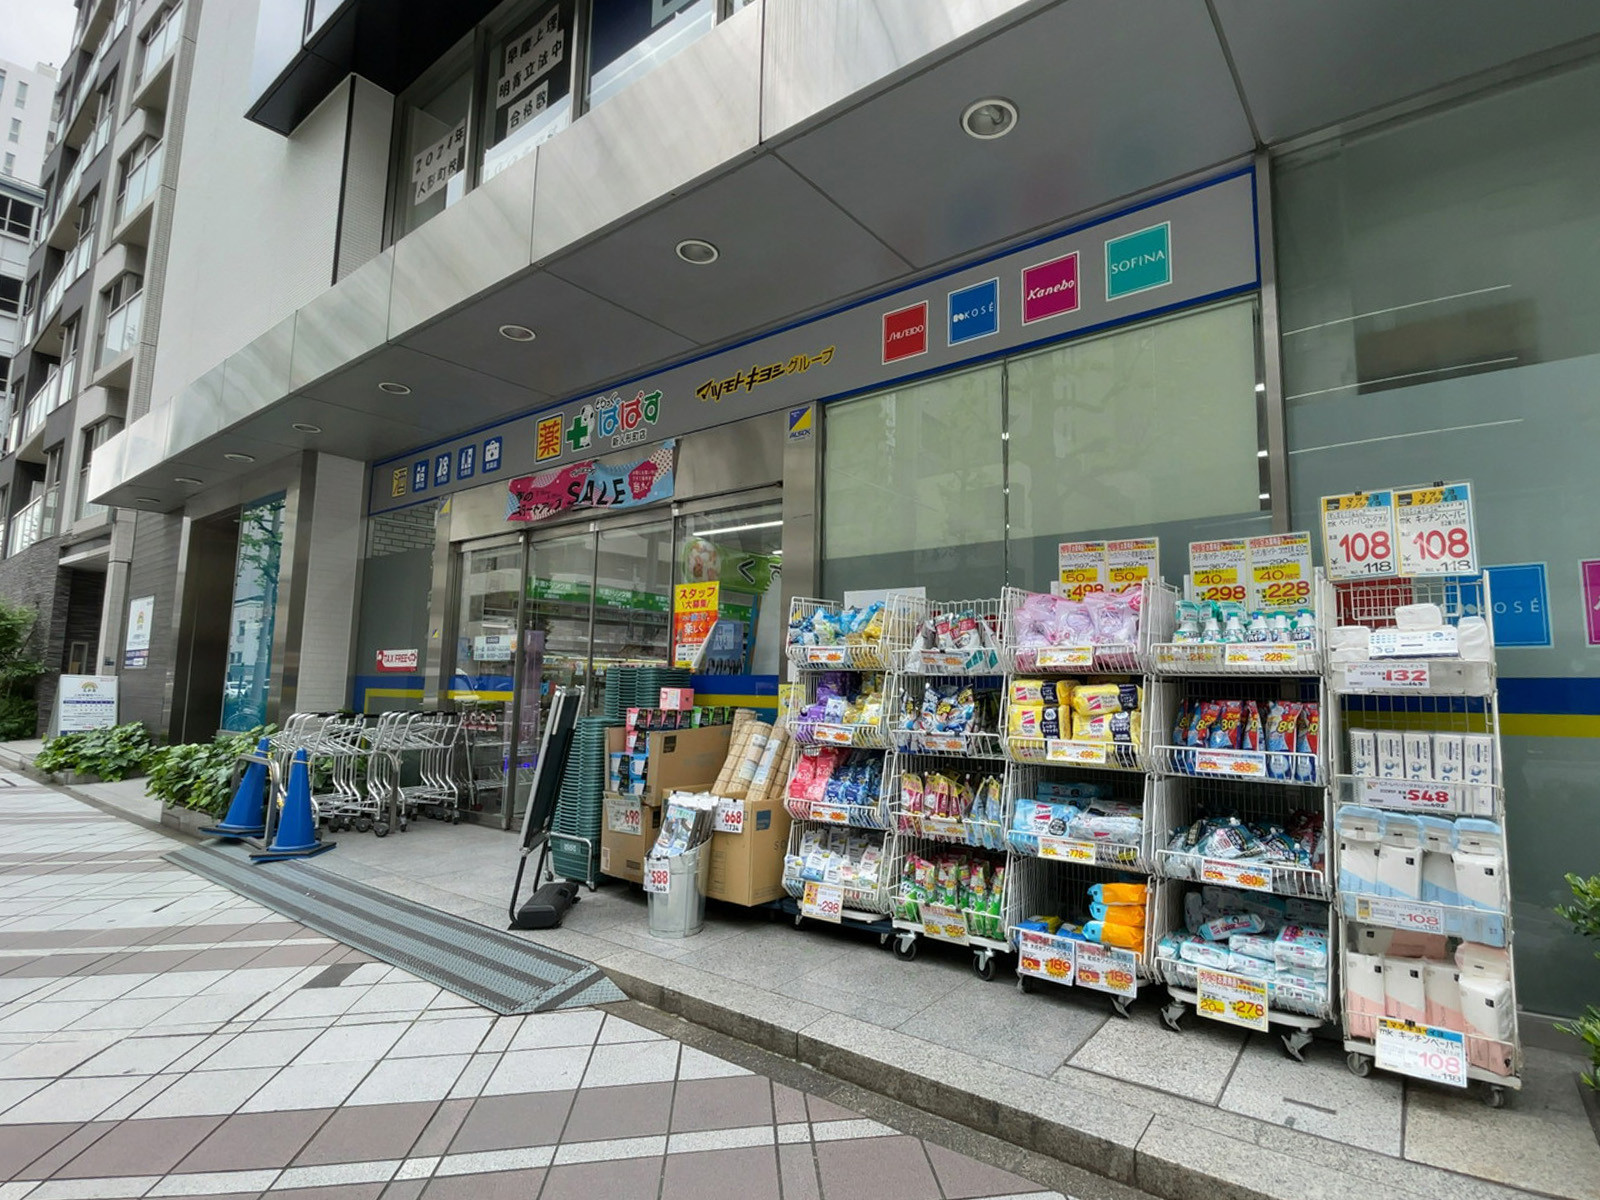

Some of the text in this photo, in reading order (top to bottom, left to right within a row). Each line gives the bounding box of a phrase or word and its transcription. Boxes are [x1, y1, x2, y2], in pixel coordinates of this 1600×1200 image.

[1111, 250, 1166, 275] SOFINA
[1027, 278, 1075, 301] Kanebo
[963, 302, 995, 319] KOSÉ
[887, 323, 925, 343] SHISEIDO
[696, 346, 836, 401] マツモトキヨシグループ
[598, 390, 662, 438] ぱぱす
[538, 419, 562, 458] 薬
[567, 477, 626, 505] SALE
[1340, 530, 1391, 562] 108
[1413, 528, 1470, 560] 108
[1364, 561, 1392, 573] 118
[1440, 560, 1471, 572] 118
[1066, 573, 1086, 583] 50
[1114, 572, 1136, 582] 50
[1200, 574, 1223, 585] 40
[1259, 570, 1285, 581] 40
[680, 587, 716, 600] スタッフ
[1206, 585, 1246, 601] 298
[1268, 580, 1311, 599] 228
[1276, 597, 1308, 606] 250
[1386, 669, 1428, 682] 132
[1407, 789, 1450, 804] 548
[724, 810, 742, 824] 668
[652, 870, 668, 884] 588
[822, 901, 840, 914] 298
[1408, 913, 1440, 926] 108
[1049, 957, 1072, 972] 189
[1110, 970, 1134, 984] 189
[1201, 1001, 1217, 1012] 20
[1236, 1000, 1265, 1017] 278
[1418, 1052, 1461, 1074] 108
